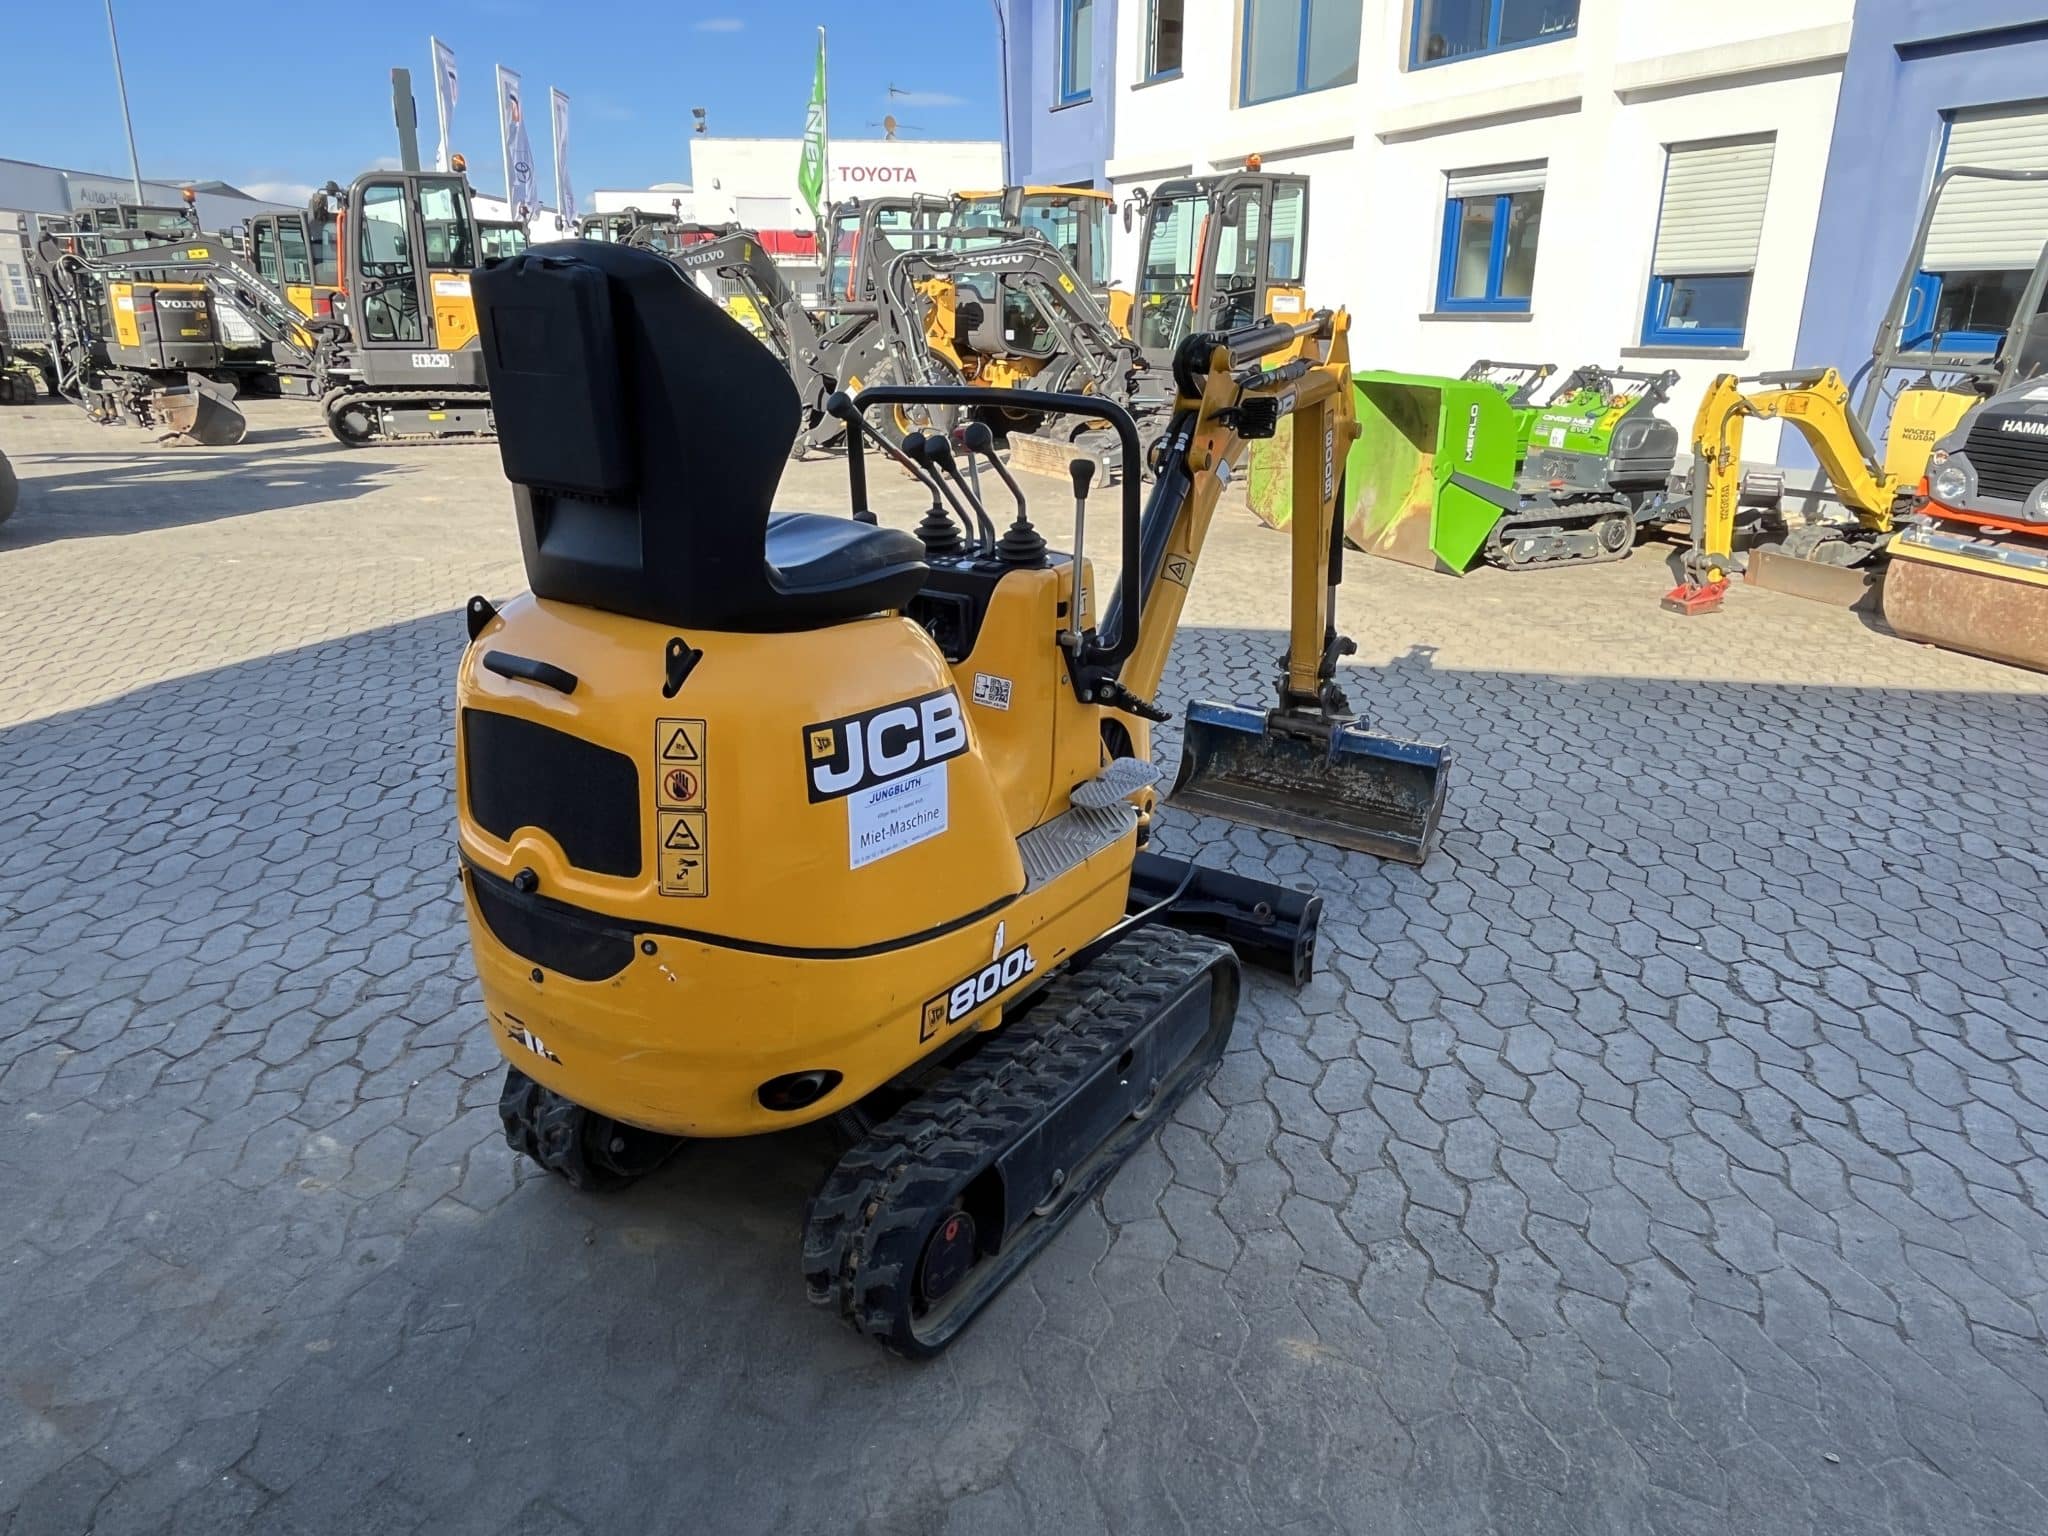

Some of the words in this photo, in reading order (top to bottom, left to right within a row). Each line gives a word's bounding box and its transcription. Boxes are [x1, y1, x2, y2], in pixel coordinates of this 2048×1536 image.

[839, 167, 917, 182] TOYOTA
[684, 250, 725, 266] VOLVO
[158, 300, 206, 309] VOLVO
[1464, 404, 1479, 461] MERLO
[813, 692, 966, 793] JCB
[814, 735, 832, 753] JCB
[869, 778, 921, 804] JUNGBLUTH
[860, 807, 940, 849] Miet-Maschine
[928, 1005, 945, 1028] JCB
